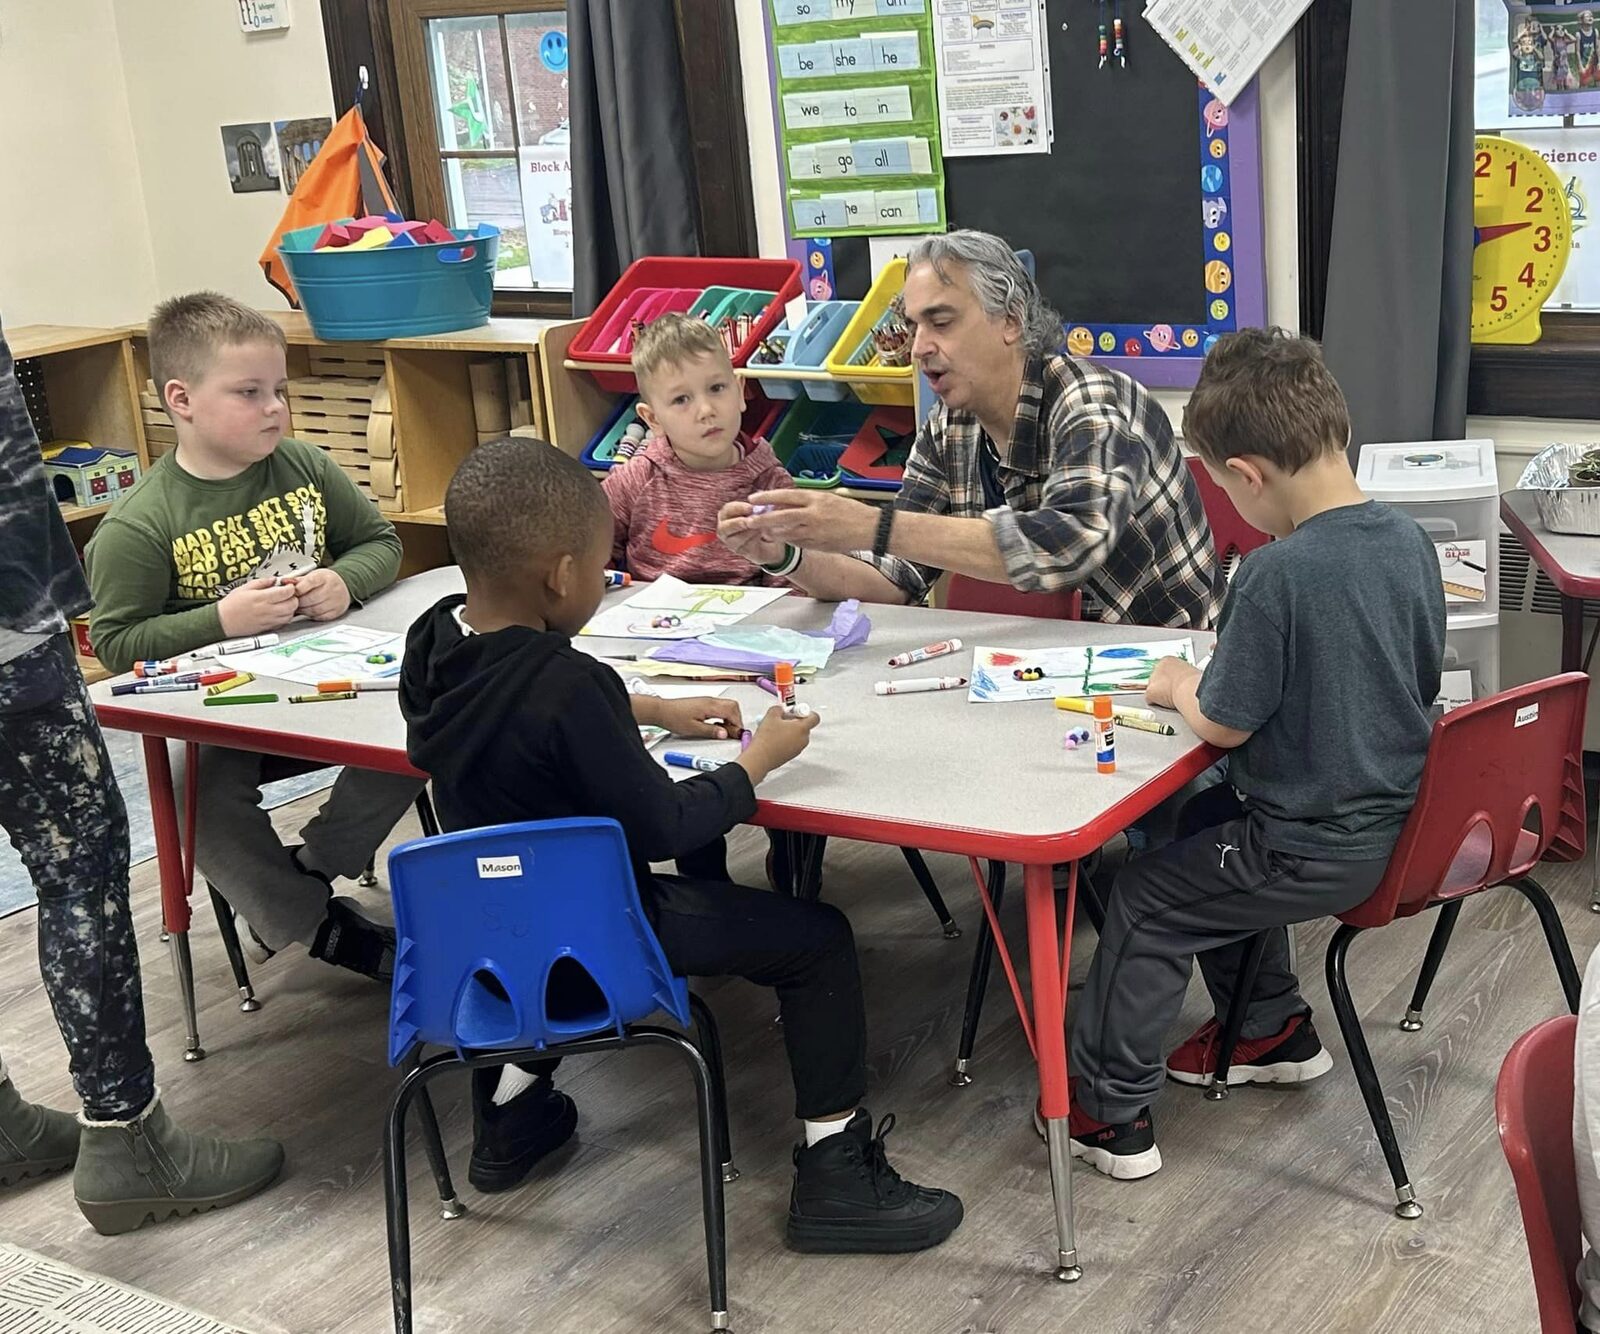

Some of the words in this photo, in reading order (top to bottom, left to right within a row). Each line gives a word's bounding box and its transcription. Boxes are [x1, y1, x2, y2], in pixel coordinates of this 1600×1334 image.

[796, 4, 811, 15] so
[797, 52, 814, 70] be
[835, 48, 856, 66] she
[881, 45, 898, 64] he
[800, 104, 820, 116] we
[843, 101, 857, 117] to
[877, 98, 889, 114] in
[812, 159, 821, 174] is
[837, 154, 853, 174] go
[874, 148, 889, 167] all
[1532, 149, 1597, 163] cience
[531, 161, 560, 173] Block
[1505, 160, 1518, 187] 1
[1525, 186, 1544, 213] 2
[1546, 187, 1556, 195] 10
[814, 210, 826, 225] at
[880, 206, 903, 218] can
[1533, 225, 1552, 252] 3
[1554, 233, 1564, 241] 15
[1517, 262, 1536, 288] 4
[1538, 279, 1548, 287] 20
[1489, 286, 1508, 312] 5
[1503, 312, 1513, 320] 25
[172, 528, 212, 555] MAD
[213, 514, 246, 536] CAT
[247, 497, 283, 523] SKT
[174, 542, 216, 571] MAD
[219, 527, 251, 552] CAT
[253, 510, 291, 538] SKT
[221, 541, 255, 566] CAT
[179, 572, 221, 587] MAD
[482, 863, 521, 873] Mason
